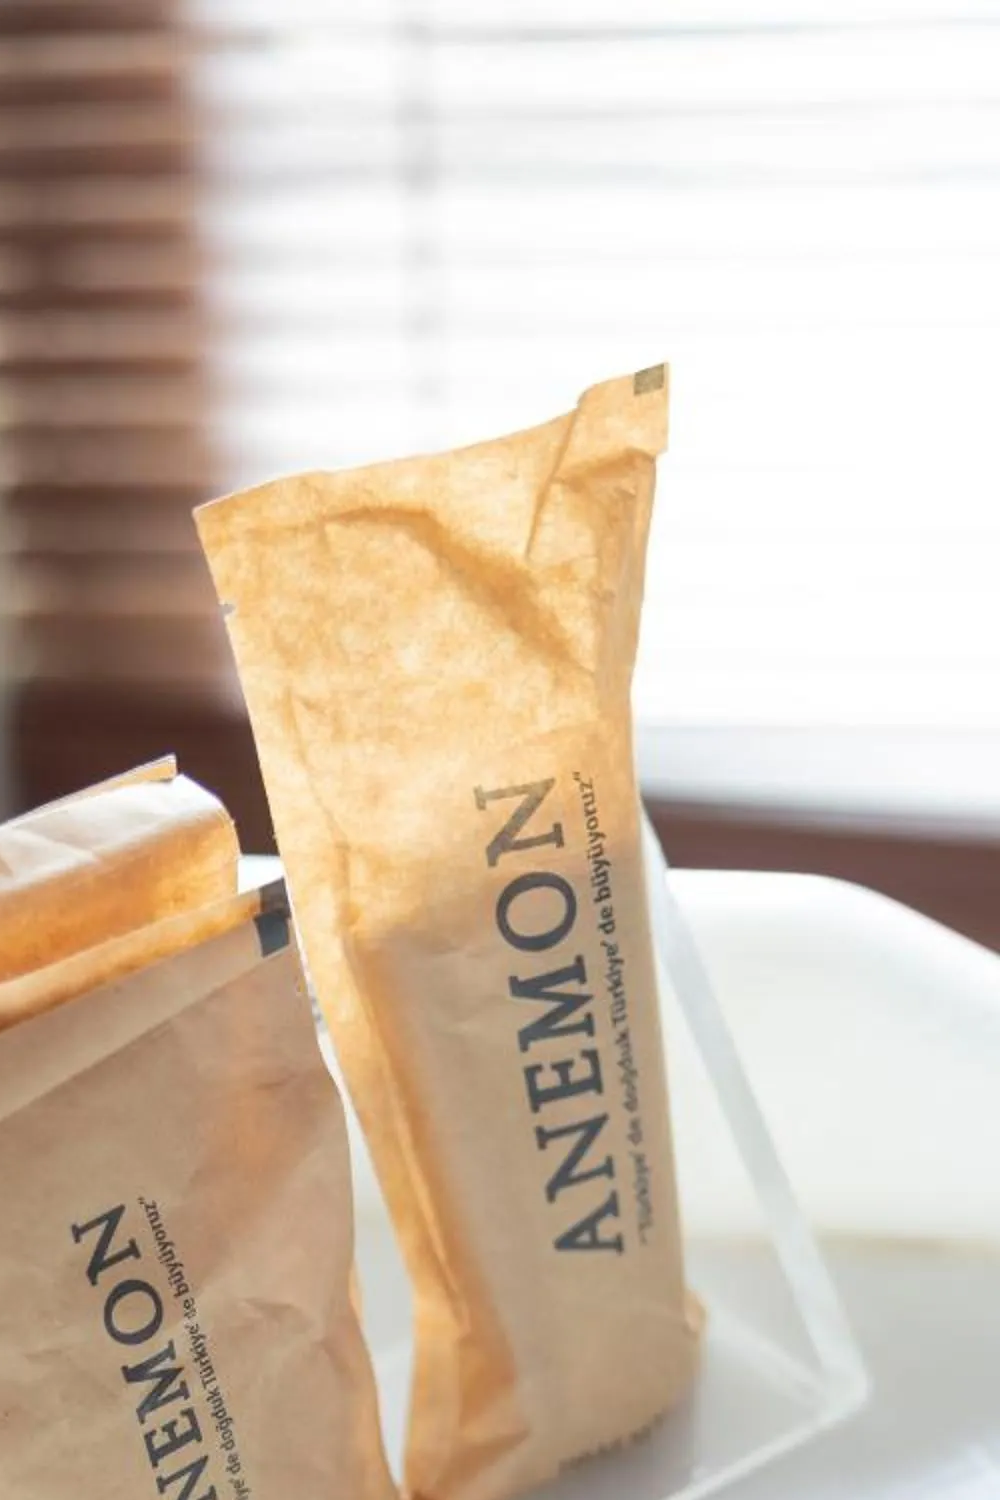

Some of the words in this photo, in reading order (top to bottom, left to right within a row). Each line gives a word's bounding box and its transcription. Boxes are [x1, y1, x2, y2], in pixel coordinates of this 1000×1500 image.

[598, 905, 616, 935] de
[473, 777, 624, 1256] ANEMON
[626, 1116, 643, 1147] de
[183, 1298, 197, 1320] de
[206, 1386, 235, 1451] doğduk
[225, 1453, 242, 1475] de
